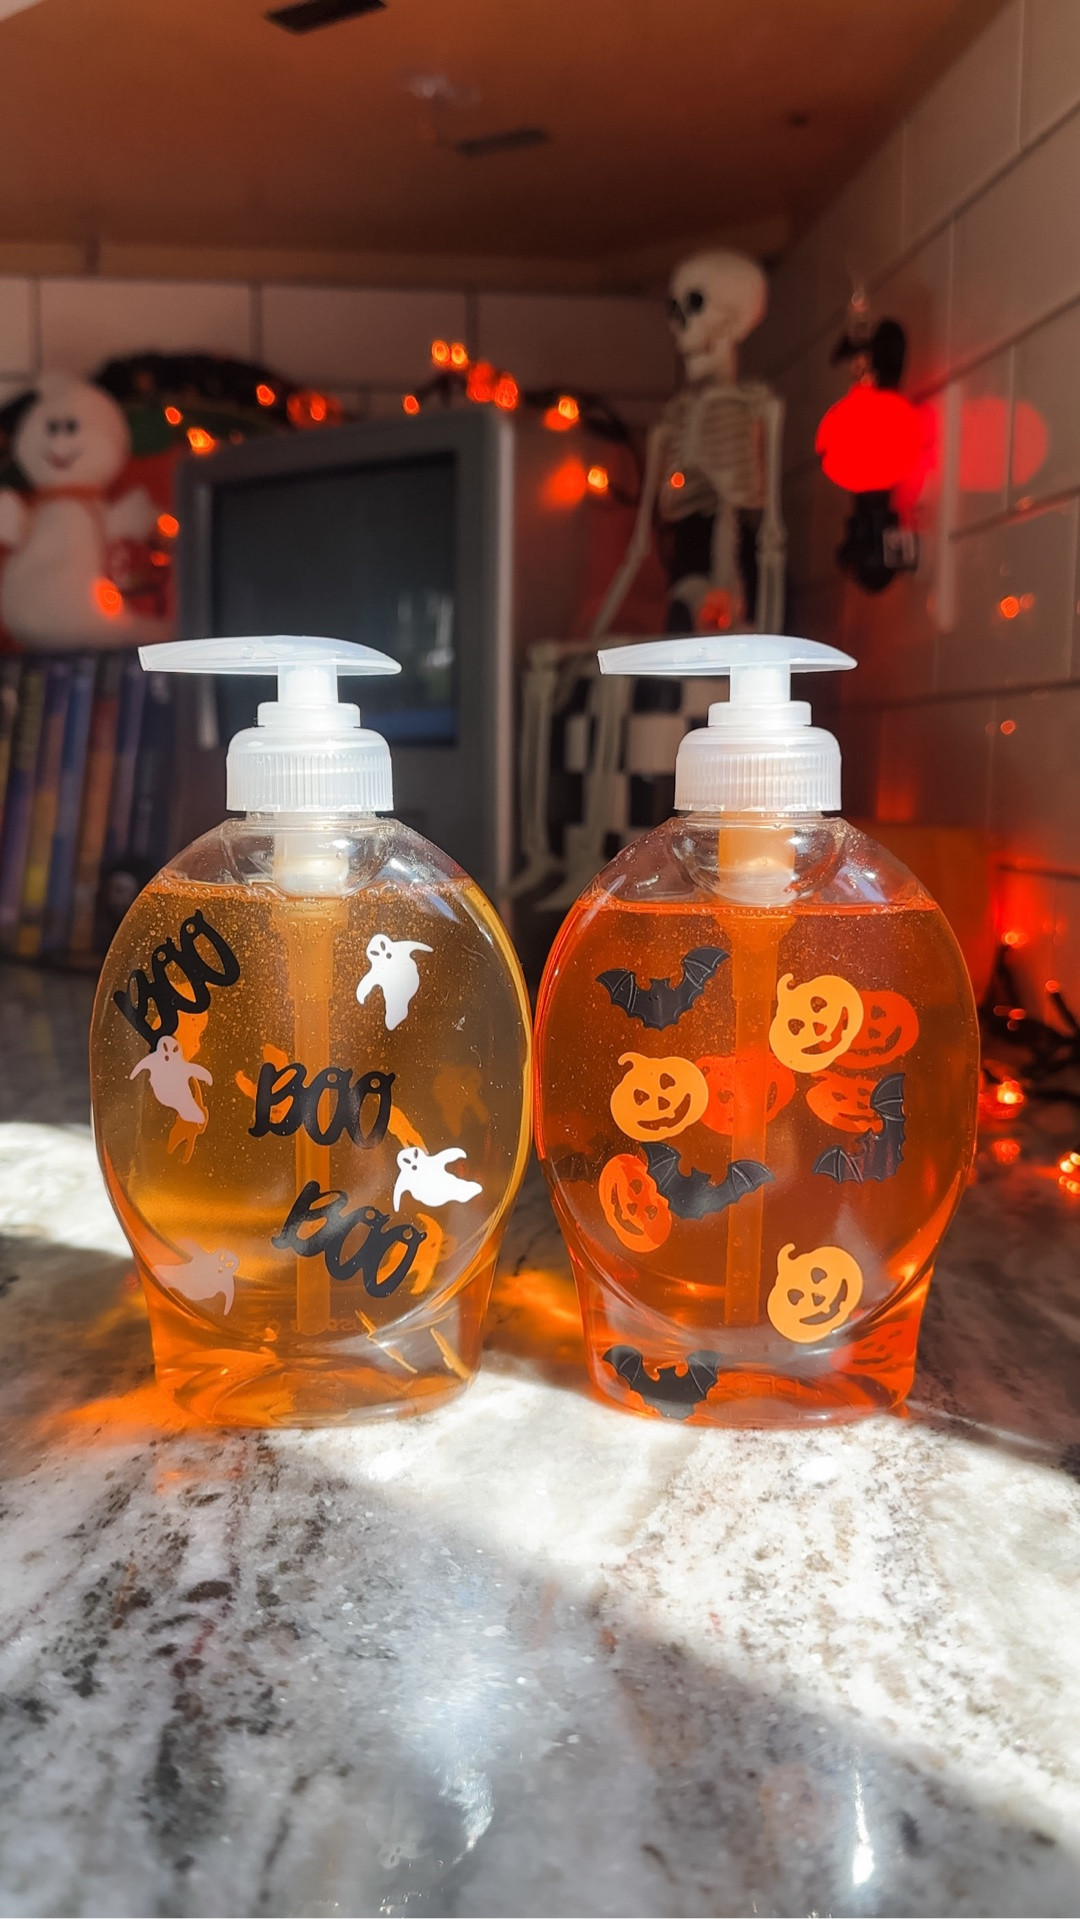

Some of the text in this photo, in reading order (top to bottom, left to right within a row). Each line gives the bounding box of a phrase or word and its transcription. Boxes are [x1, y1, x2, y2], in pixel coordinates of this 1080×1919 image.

[113, 909, 240, 1053] BOO
[248, 1062, 396, 1149] BOO
[271, 1181, 427, 1298] BOO
